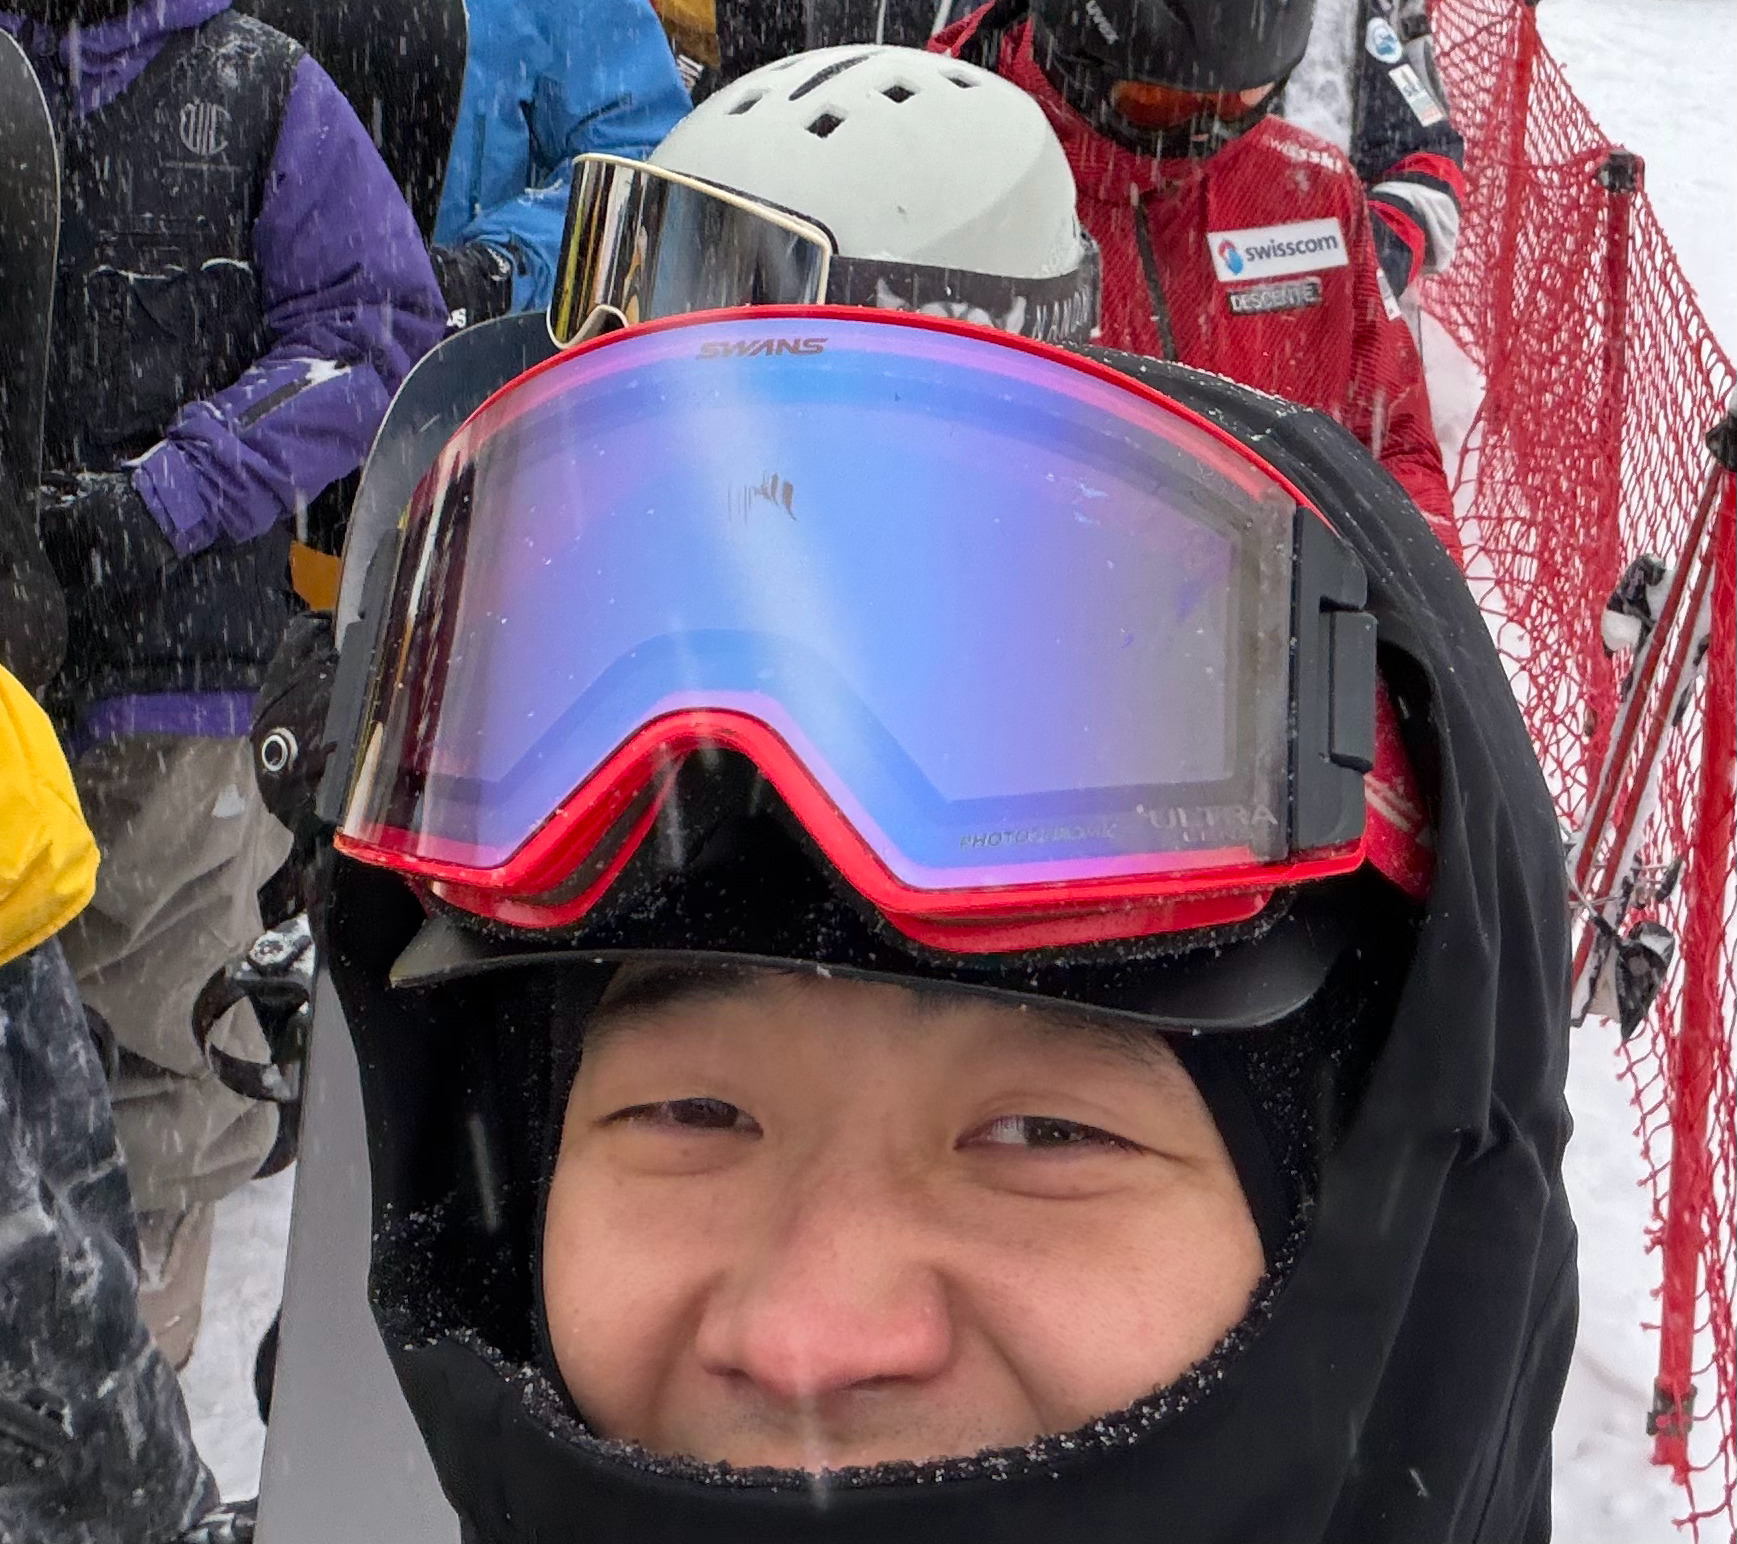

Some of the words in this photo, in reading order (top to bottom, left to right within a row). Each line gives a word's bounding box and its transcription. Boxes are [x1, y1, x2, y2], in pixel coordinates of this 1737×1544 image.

[1245, 234, 1338, 263] swisscom
[1230, 282, 1319, 311] DESCENTE
[696, 337, 828, 360] SWANS
[1149, 803, 1278, 829] ULTRA
